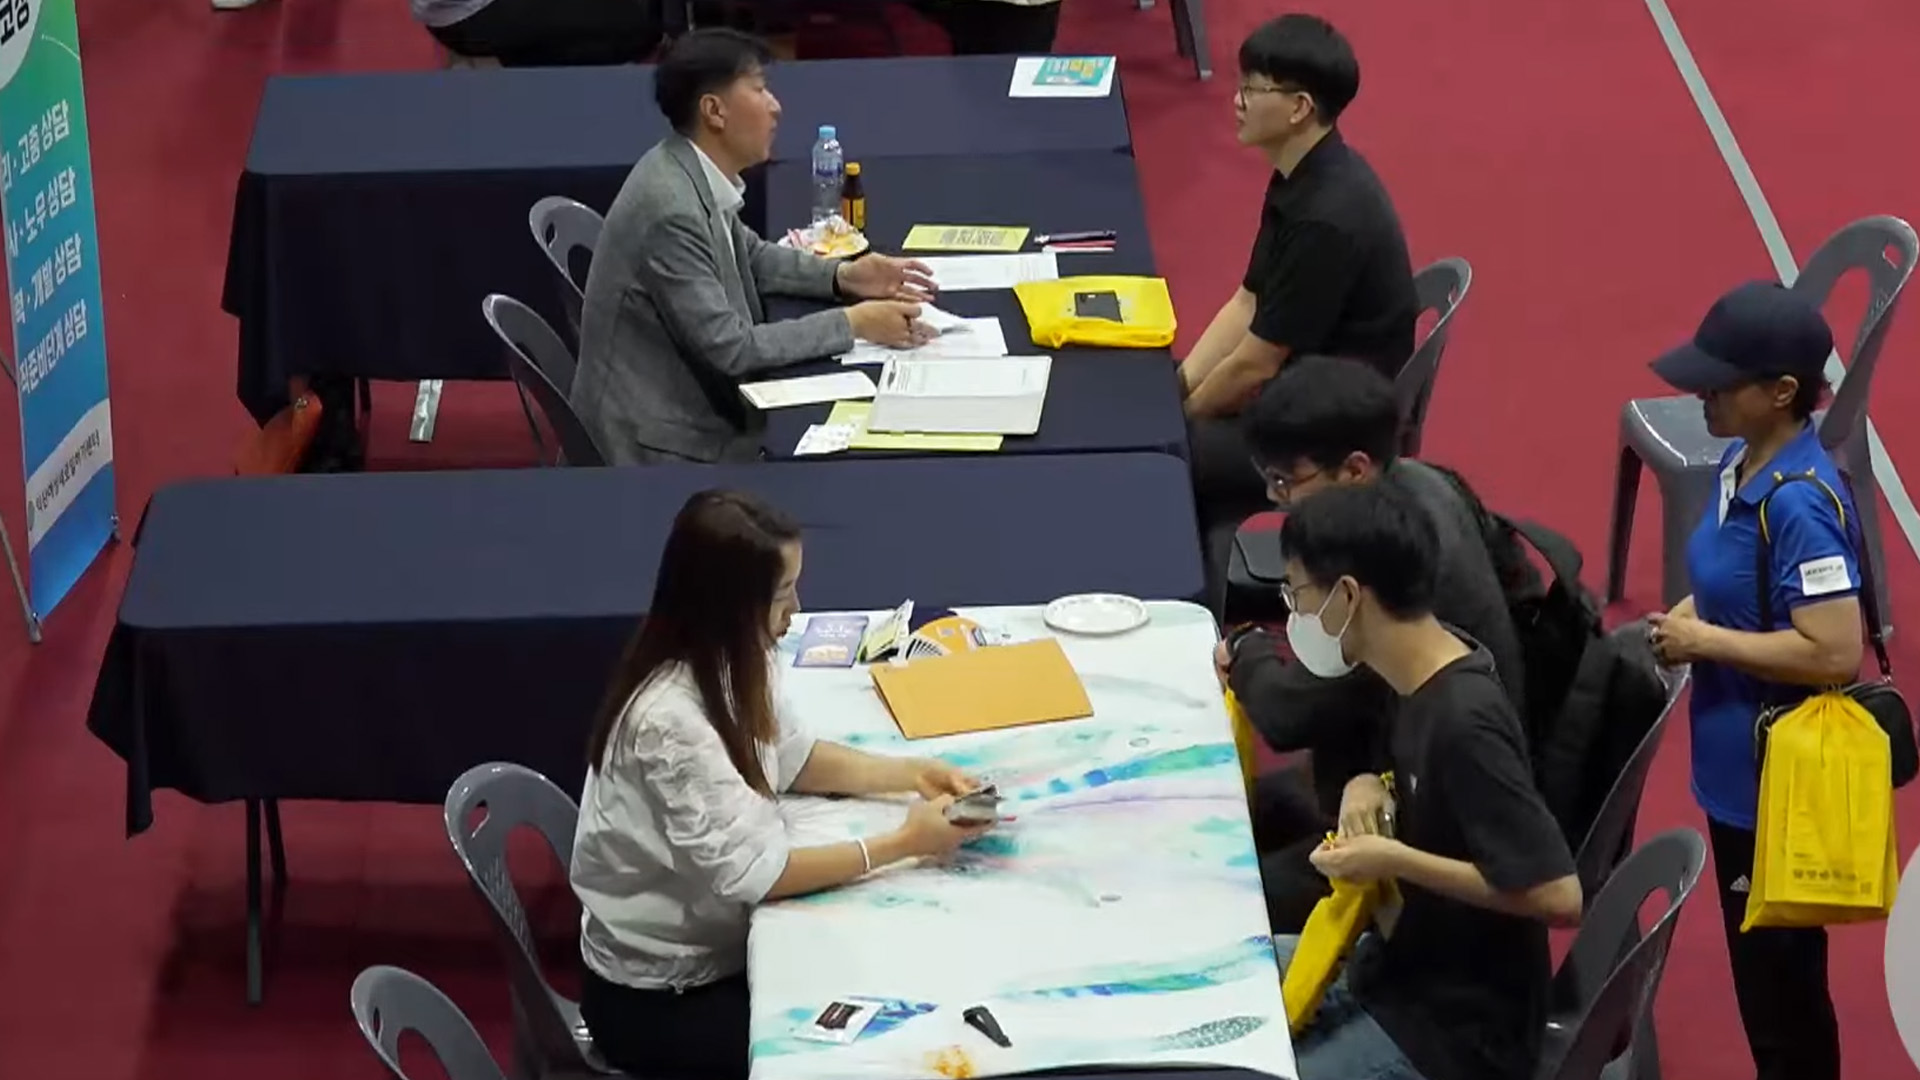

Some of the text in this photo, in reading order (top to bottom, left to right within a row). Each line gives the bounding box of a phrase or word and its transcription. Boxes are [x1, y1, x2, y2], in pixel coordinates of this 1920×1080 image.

[41, 99, 70, 151] 상담
[48, 167, 76, 219] 상담
[54, 232, 82, 285] 상담
